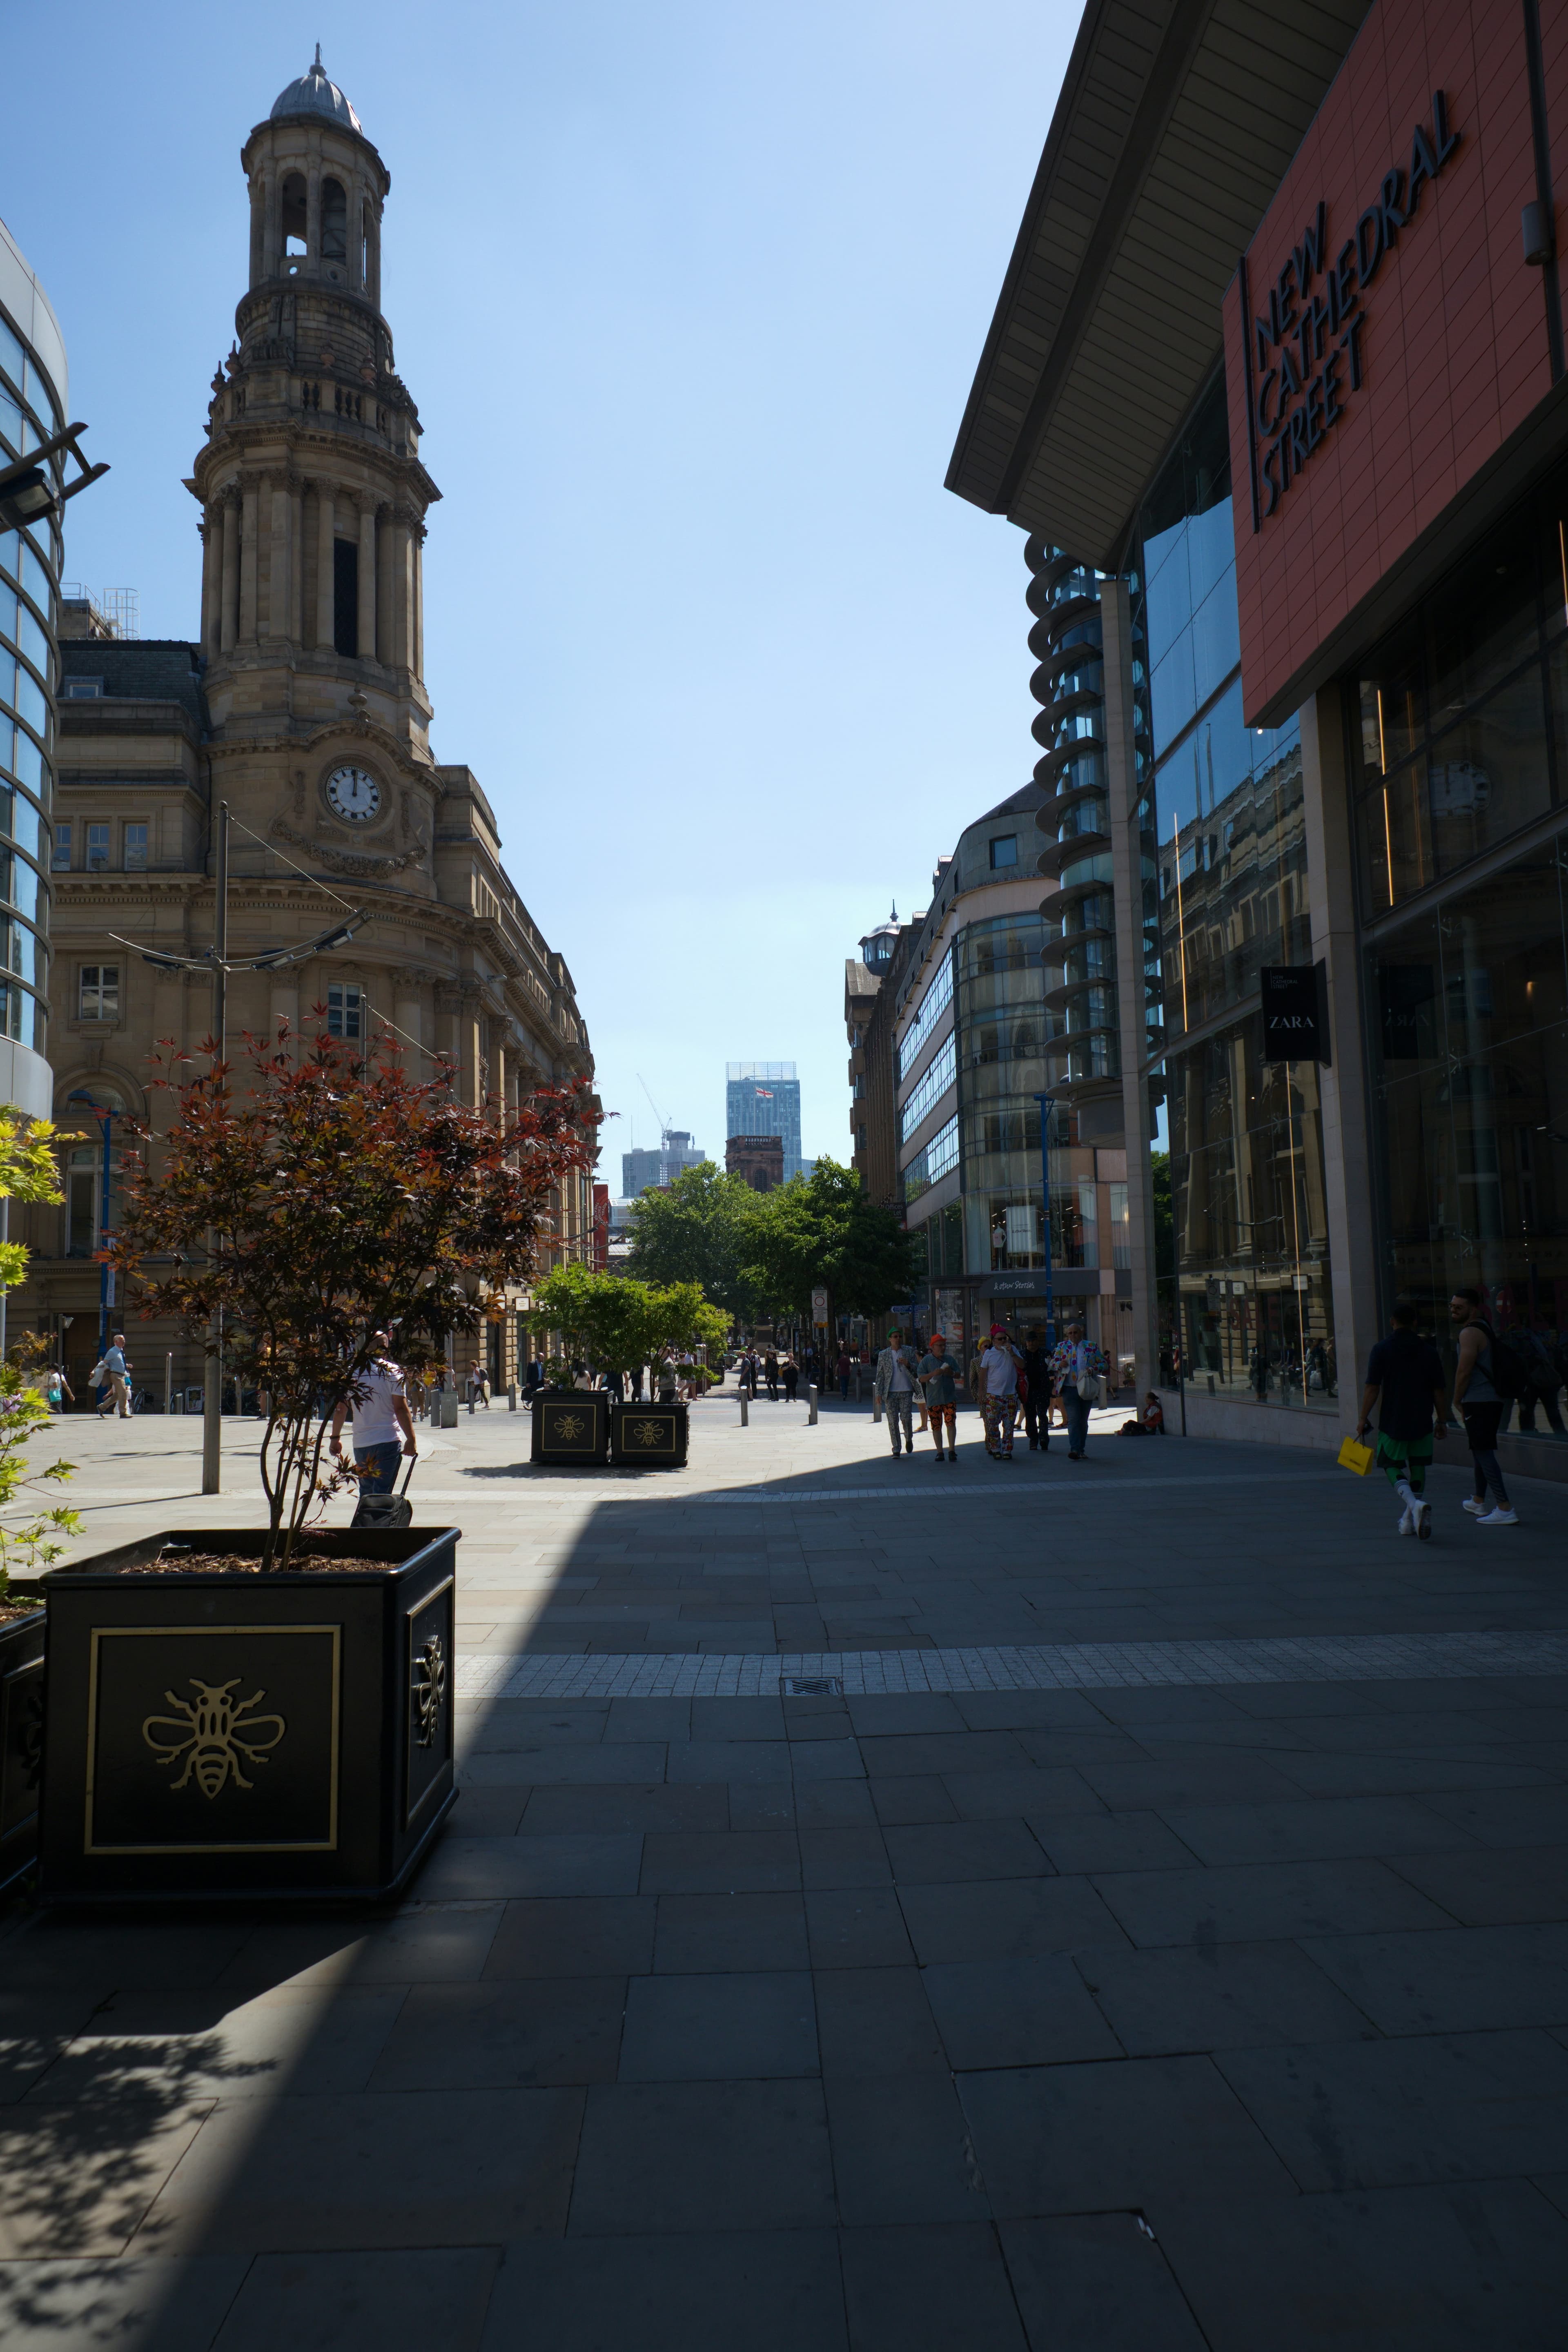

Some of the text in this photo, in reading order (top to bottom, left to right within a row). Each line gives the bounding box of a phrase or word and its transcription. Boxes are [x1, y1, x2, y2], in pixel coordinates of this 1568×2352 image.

[1256, 201, 1326, 372] NEW
[1257, 89, 1462, 438] CATHEDRAL
[1263, 310, 1365, 517] STREET
[1269, 1016, 1315, 1029] ZARA
[994, 1281, 1035, 1290] & other Stories
[1229, 1296, 1281, 1331] SALE
